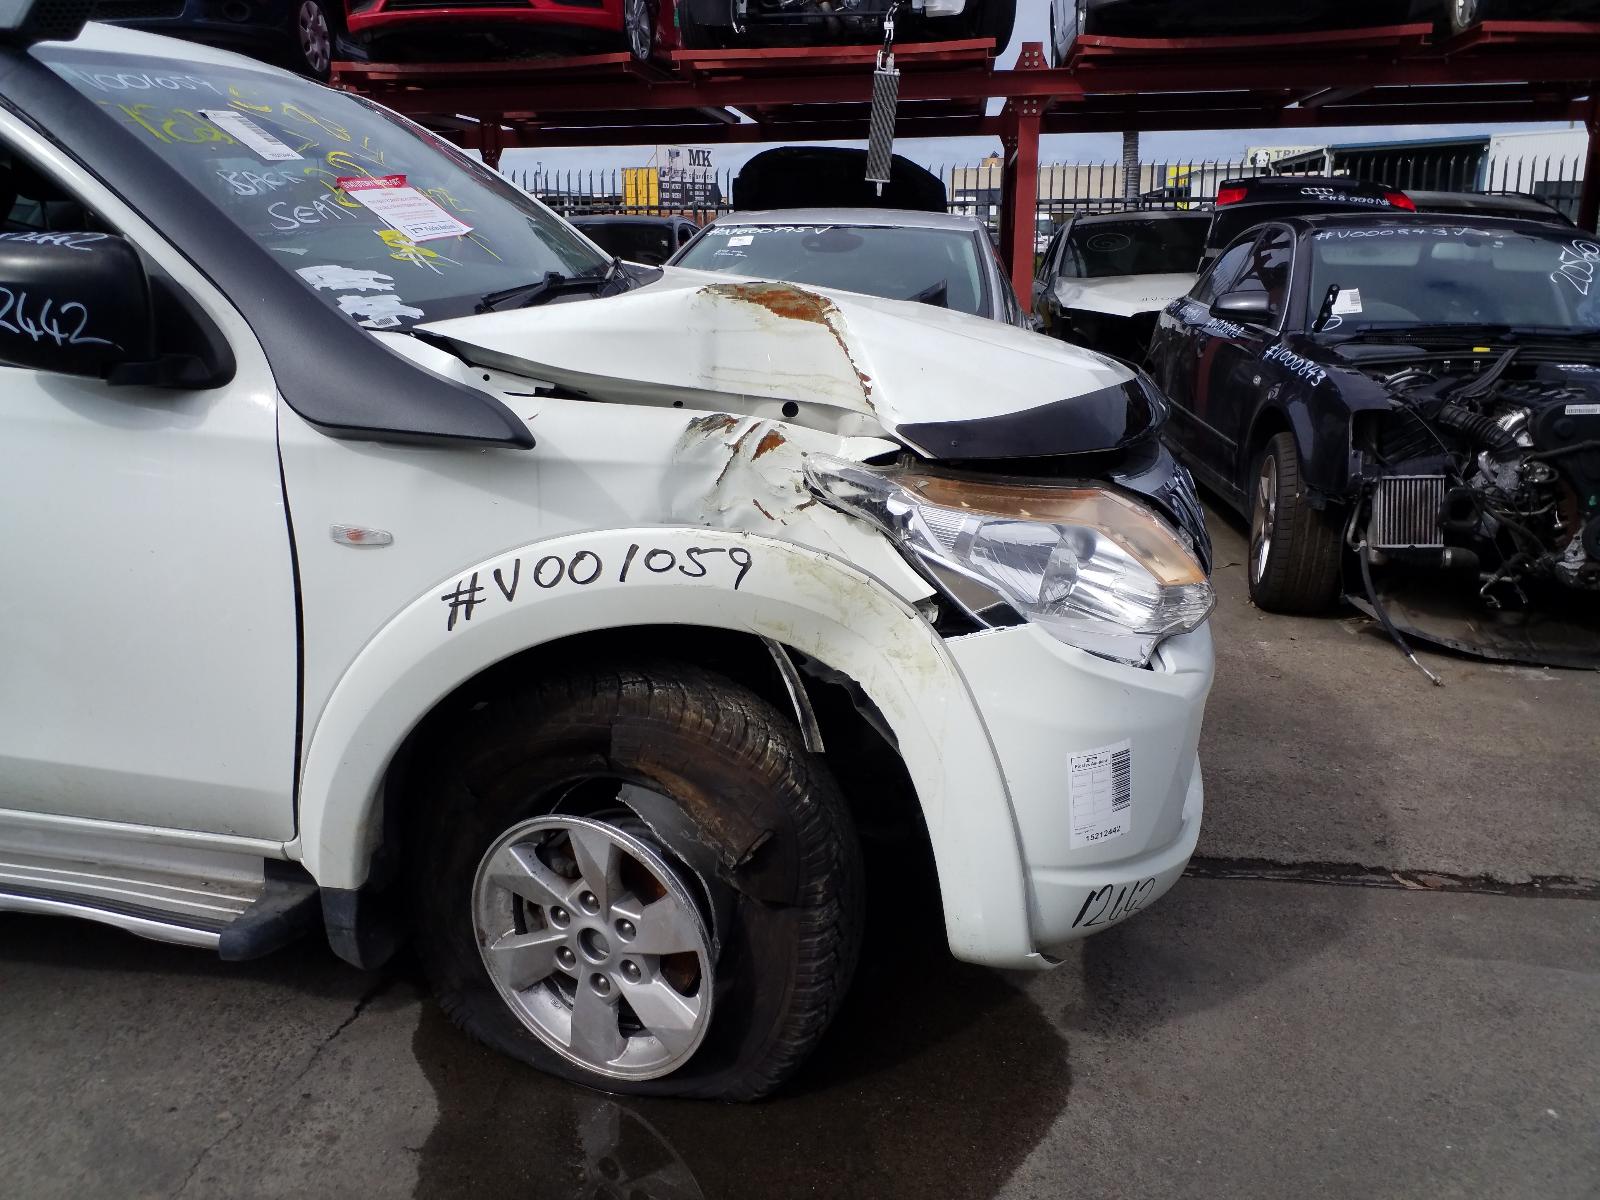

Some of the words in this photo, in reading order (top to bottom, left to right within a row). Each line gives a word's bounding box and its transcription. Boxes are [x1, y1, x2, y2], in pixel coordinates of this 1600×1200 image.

[687, 149, 713, 168] MK
[267, 193, 357, 230] SEAT
[1262, 342, 1327, 387] #V000843
[441, 543, 753, 632] #V001059
[1086, 825, 1121, 841] 15212442
